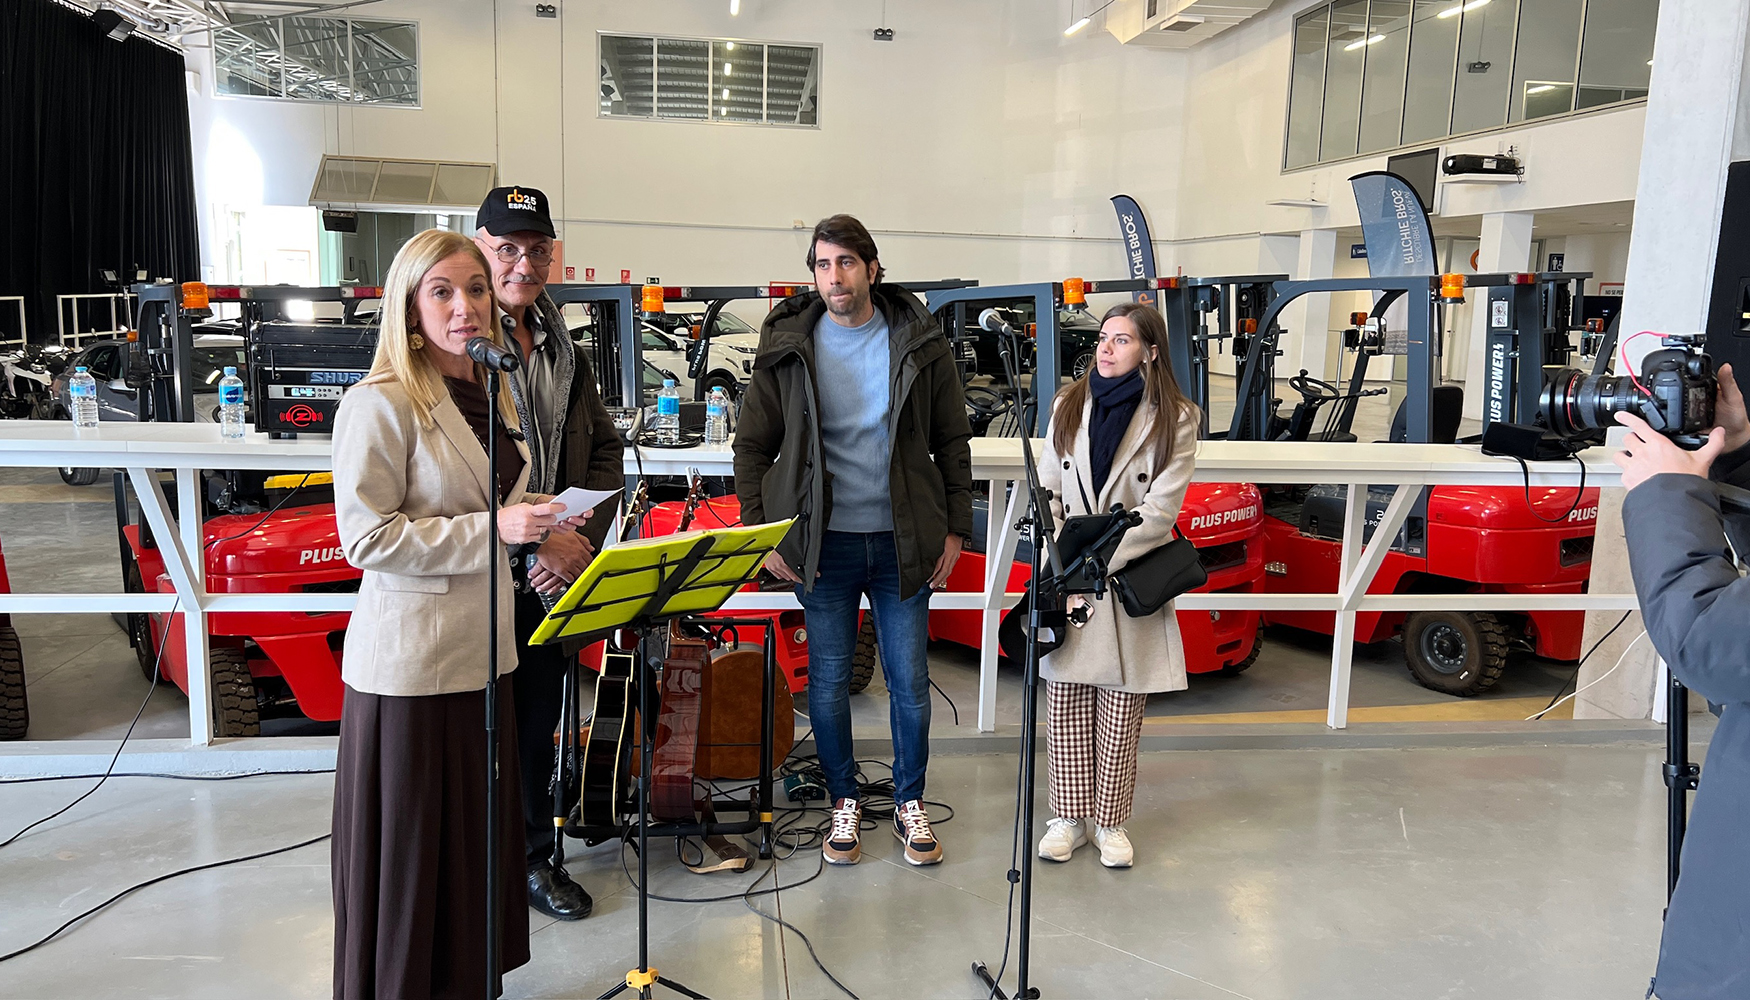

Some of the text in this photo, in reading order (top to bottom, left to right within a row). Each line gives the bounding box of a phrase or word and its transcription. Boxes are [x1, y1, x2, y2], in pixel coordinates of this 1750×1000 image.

[508, 203, 537, 212] ESPAÑA
[310, 372, 368, 384] SHUR
[1490, 349, 1504, 423] LUS POWER
[1190, 505, 1255, 530] PLUS POWER
[1568, 506, 1598, 522] PLUS
[299, 546, 346, 565] PLUS
